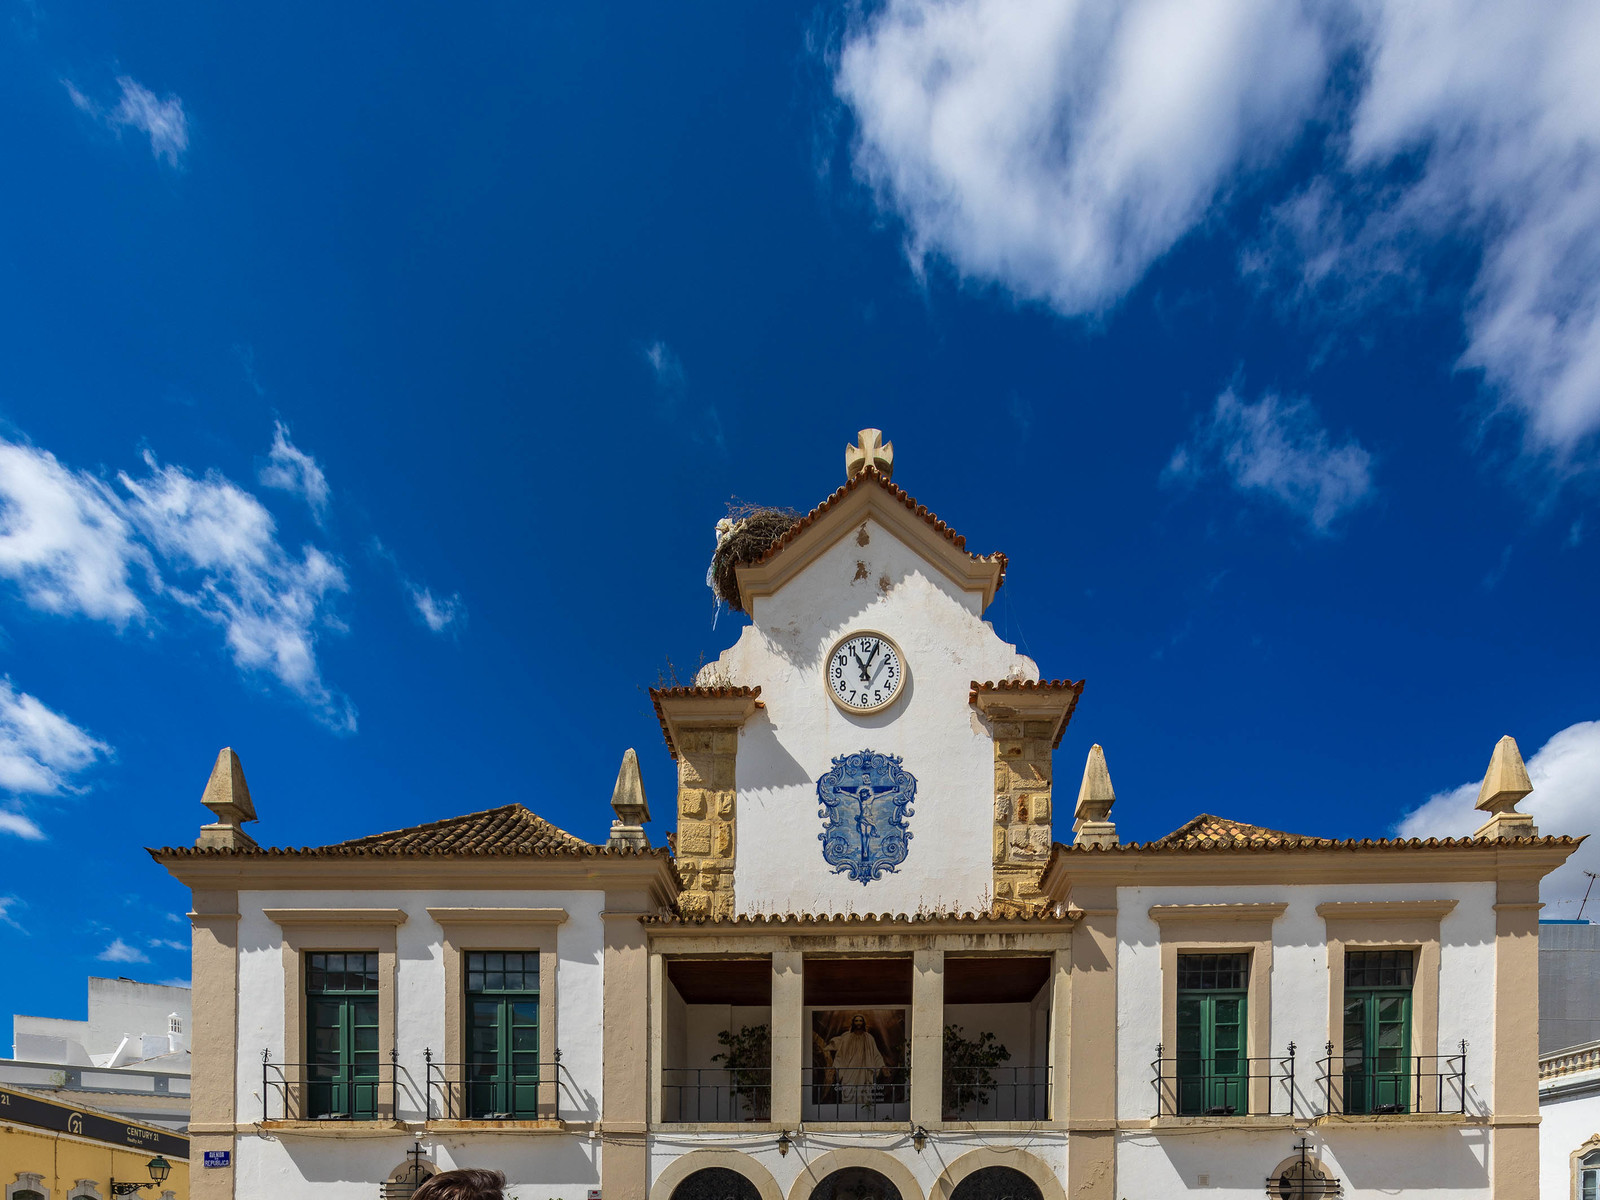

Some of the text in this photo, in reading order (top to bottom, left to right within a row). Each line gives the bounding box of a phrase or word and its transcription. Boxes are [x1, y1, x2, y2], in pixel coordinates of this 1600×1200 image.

[848, 645, 856, 657] 11
[860, 641, 871, 652] 12
[838, 654, 848, 666] 10
[884, 653, 891, 665] 2
[835, 667, 842, 678] 9
[887, 666, 895, 678] 3
[840, 680, 846, 691] 8
[884, 680, 891, 691] 4
[849, 690, 857, 702] 7
[861, 693, 868, 704] 6
[874, 690, 882, 701] 5
[126, 1127, 160, 1142] CENTURY 21
